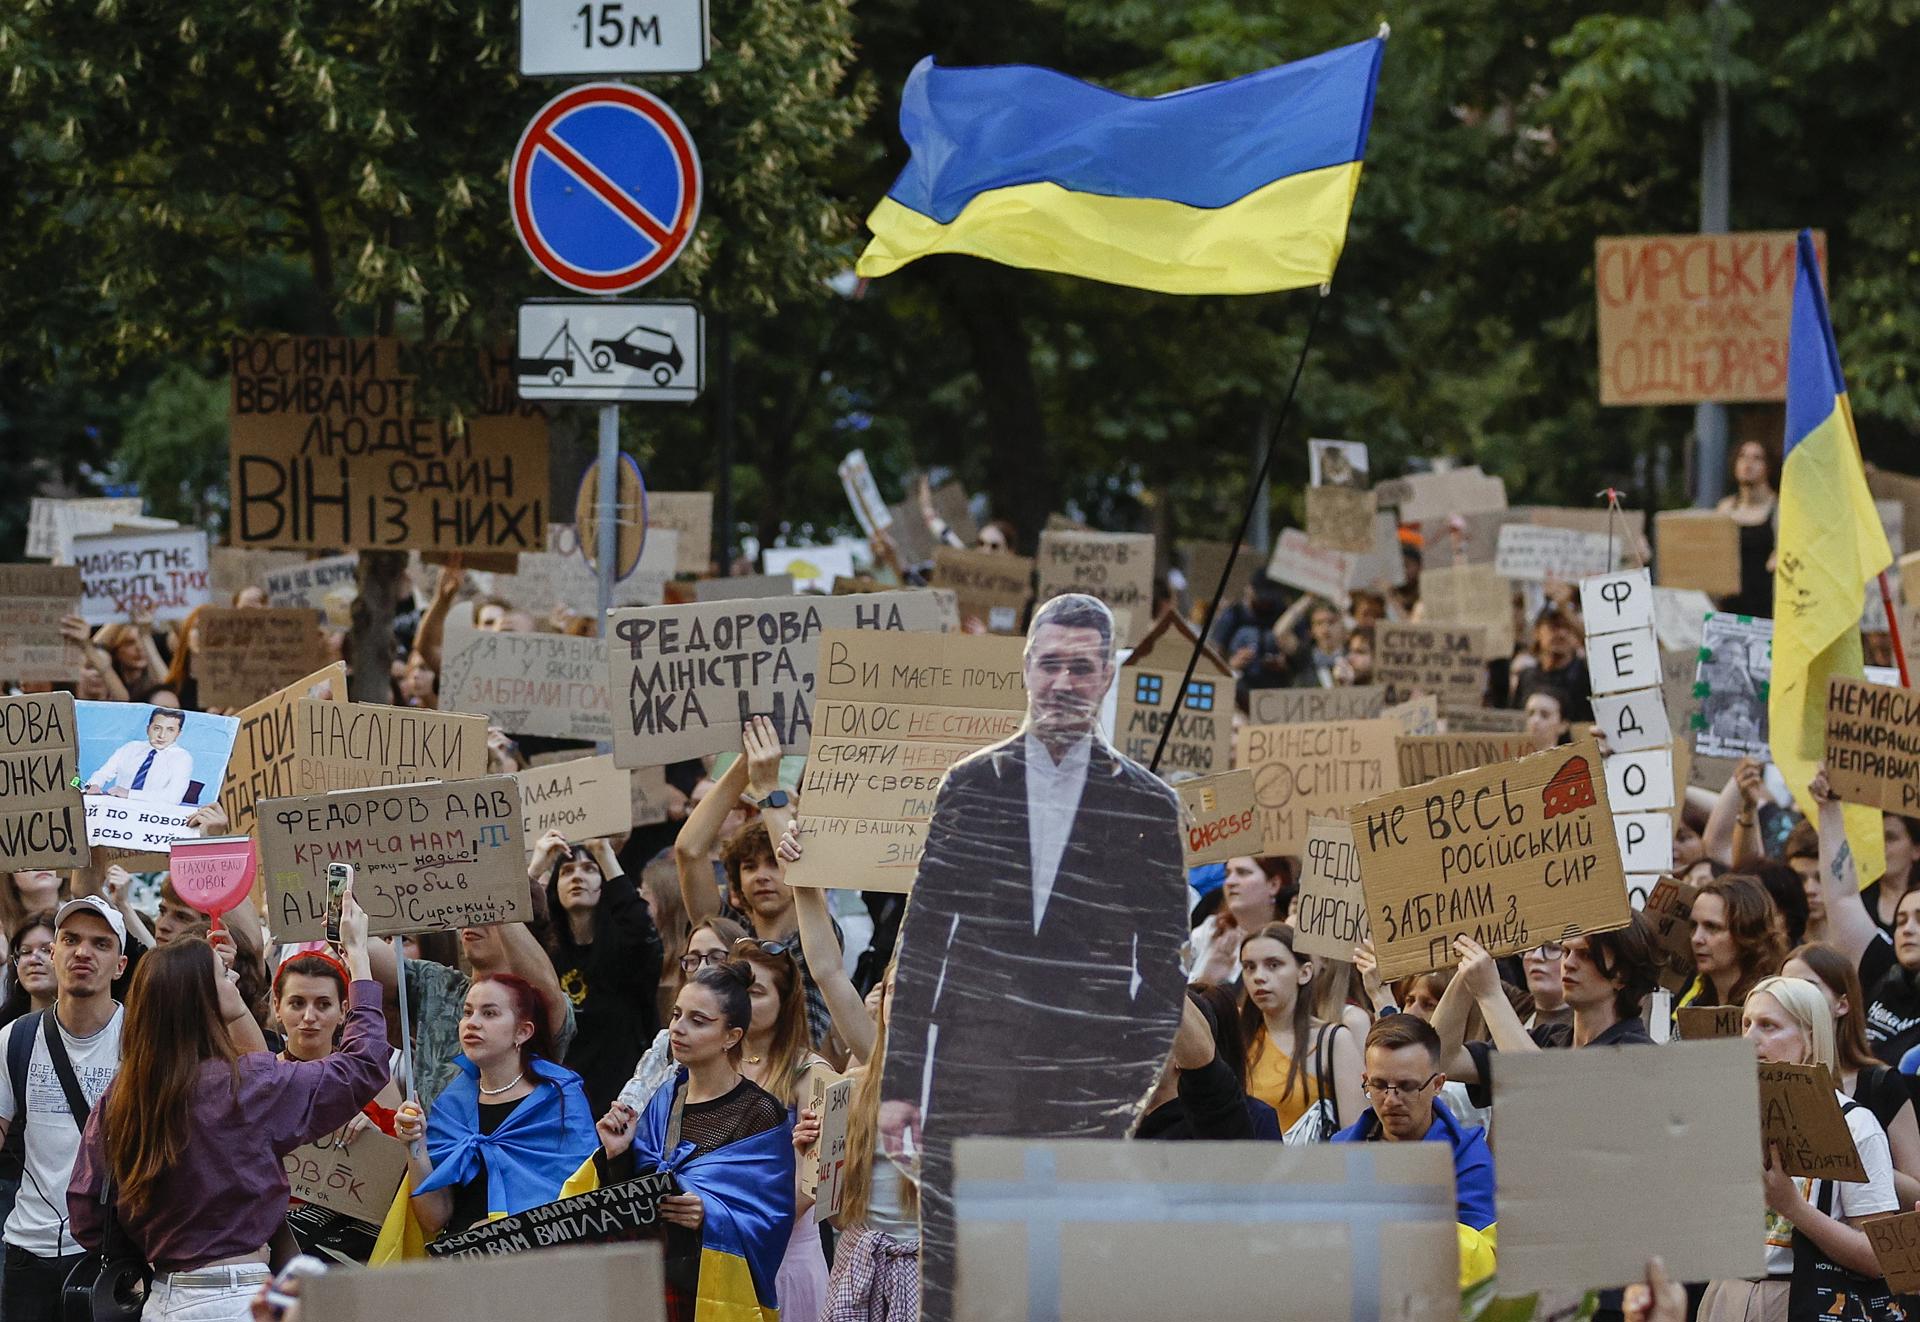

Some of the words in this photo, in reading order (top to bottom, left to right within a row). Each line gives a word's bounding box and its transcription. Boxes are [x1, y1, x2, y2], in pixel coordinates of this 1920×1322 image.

[236, 376, 411, 416] ВБИВАЮТ
[238, 454, 350, 543] ВІН
[388, 455, 514, 498] ОДИН
[367, 494, 409, 545] ІЗ
[432, 499, 543, 549] НИХ!
[615, 604, 823, 660] ФЕДОРОВА
[309, 704, 463, 773] НАСЛІДКИ
[823, 703, 901, 737] ГОЛОС
[908, 711, 938, 735] НЕ
[817, 744, 900, 768] СТОЯТИ
[1247, 724, 1361, 764] ВИНЕСІТЬ
[807, 768, 860, 800] ЦІНУ
[1295, 759, 1382, 797] СМІТТЯ
[276, 795, 430, 835] ФЕДОРОВ
[445, 790, 513, 821] ДАВ
[538, 806, 587, 831] НАРОД
[855, 820, 918, 837] ВАШИХ
[1299, 893, 1371, 944] СИРСЬК
[1381, 882, 1495, 943] ЗАБРАЛИ
[433, 1218, 524, 1254] МУСИМО
[532, 1193, 668, 1247] ВИПЛАЧУ
